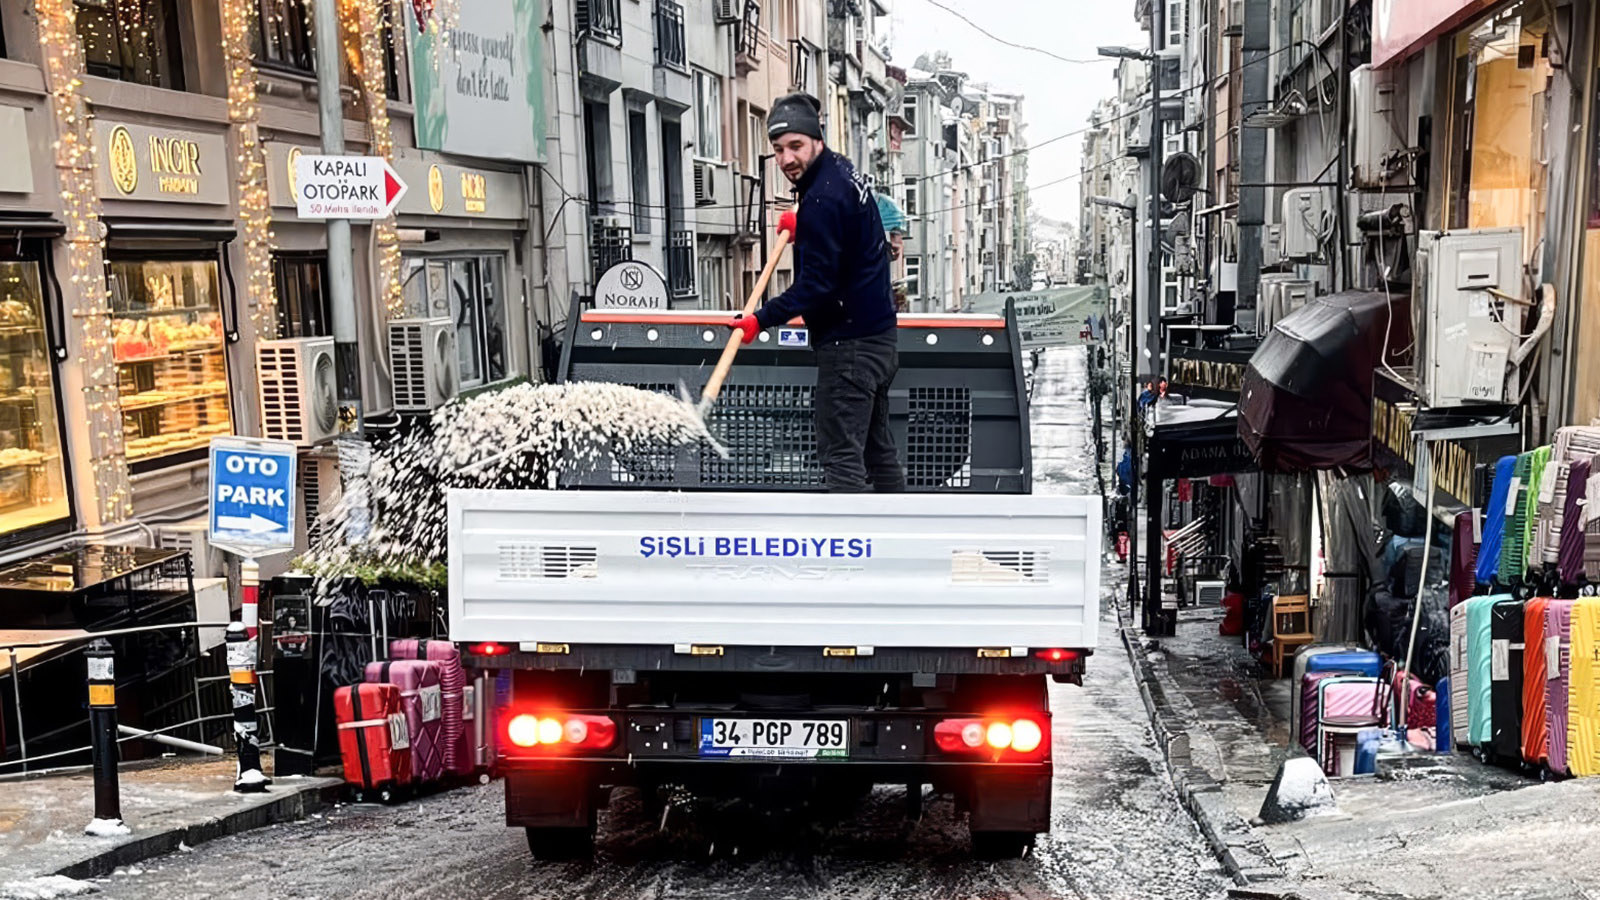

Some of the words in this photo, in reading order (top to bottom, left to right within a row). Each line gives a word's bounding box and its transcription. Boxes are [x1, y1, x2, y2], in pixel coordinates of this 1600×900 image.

[314, 160, 367, 177] KAPALI
[303, 184, 380, 200] OTOPARK
[307, 203, 322, 214] 50
[604, 293, 660, 308] NORAH
[225, 455, 279, 477] OTO
[217, 484, 286, 507] PARK
[714, 721, 741, 745] 34
[752, 722, 792, 746] PGP
[802, 723, 844, 747] 789
